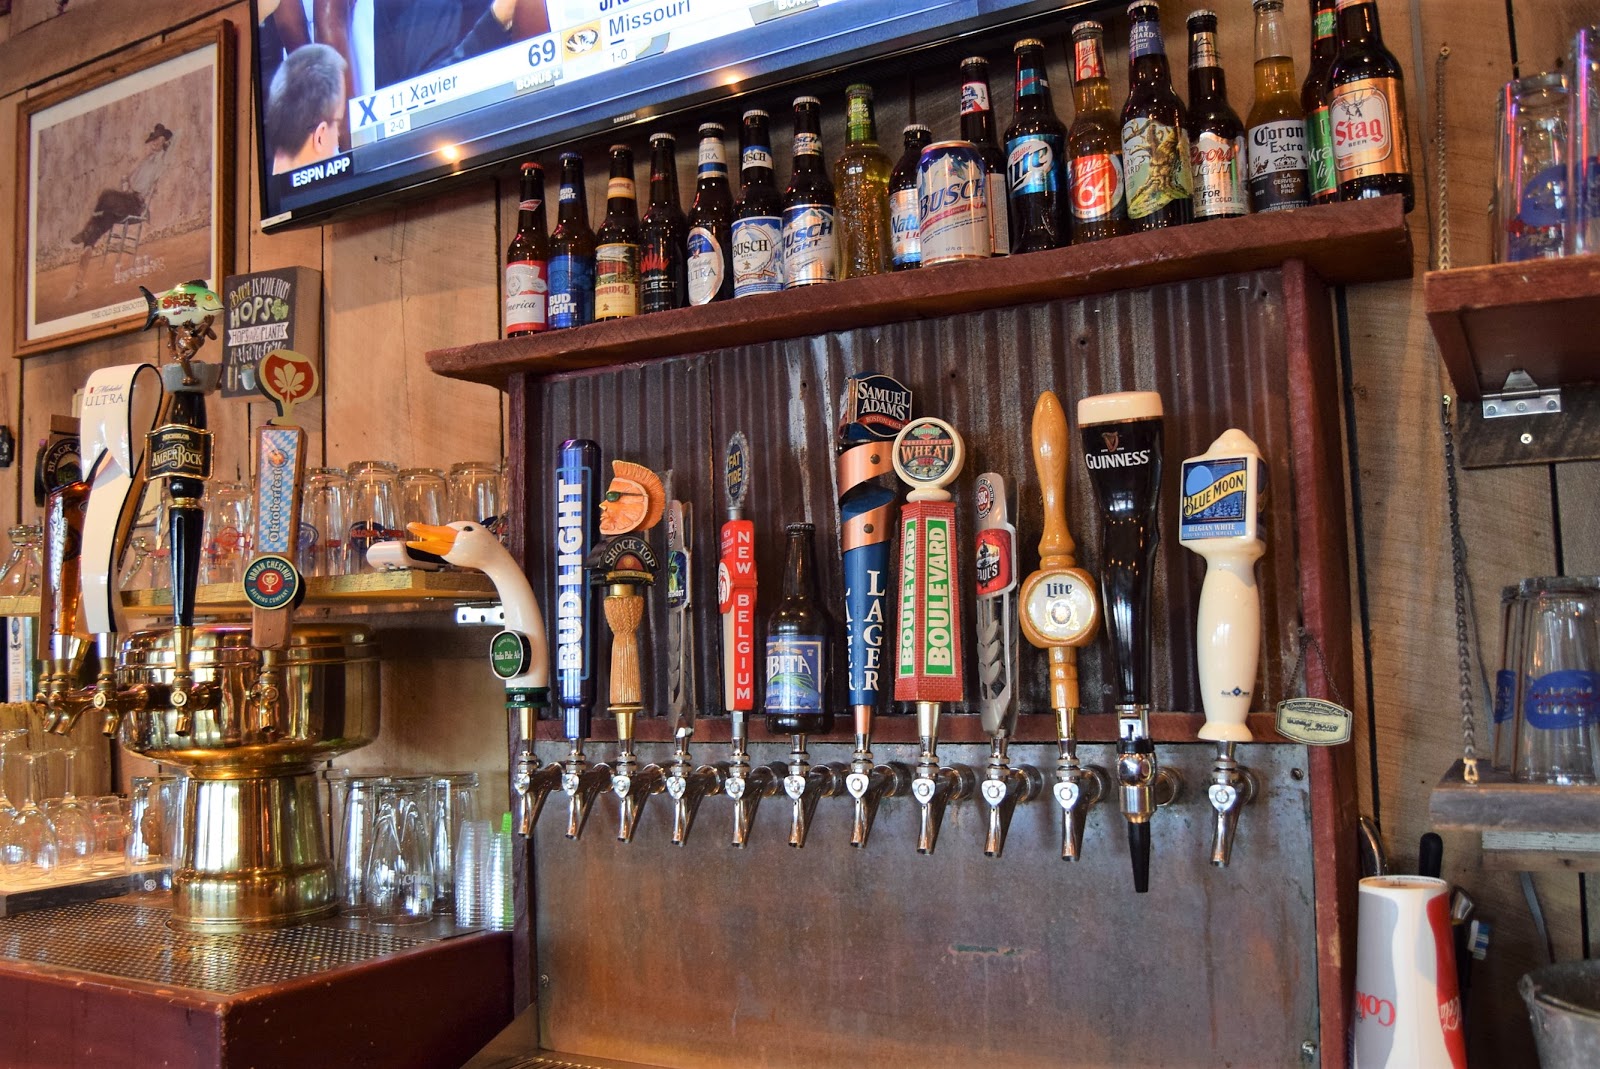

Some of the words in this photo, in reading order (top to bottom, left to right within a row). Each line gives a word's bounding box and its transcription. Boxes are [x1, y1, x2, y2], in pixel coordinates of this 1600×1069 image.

[608, 0, 691, 37] Missouri
[527, 39, 556, 67] 69
[409, 74, 459, 102] Xavier
[358, 95, 379, 126] X
[613, 112, 637, 124] SAMSUNG
[389, 118, 405, 133] 2-0
[1254, 126, 1304, 147] Coron
[1335, 118, 1384, 147] Stag
[1011, 144, 1032, 161] Miller
[1270, 140, 1304, 154] Extra
[1348, 139, 1367, 148] BEER
[1190, 146, 1233, 166] Coors
[292, 164, 325, 188] ESPN
[325, 156, 351, 178] APP
[1008, 146, 1048, 192] Lite
[1073, 158, 1109, 182] Miller
[1355, 167, 1364, 176] 12
[1077, 172, 1111, 208] 64
[1273, 177, 1301, 185] CERVEZA
[920, 178, 984, 221] BUSCH
[1203, 190, 1220, 198] FOR
[733, 239, 769, 258] BUSCH
[785, 239, 821, 259] LIGHT
[549, 292, 571, 306] BUD
[230, 296, 273, 328] HOPS
[232, 329, 249, 342] HOPS
[260, 323, 286, 341] PLANTS
[85, 393, 125, 407] ULTRA
[858, 381, 910, 409] SAMUEL
[861, 398, 906, 421] ADAMS
[865, 416, 888, 425] BOSTON
[888, 420, 904, 430] LAGE
[47, 443, 72, 473] BLACK
[729, 451, 741, 468] FAT
[901, 445, 952, 465] WHEAT
[1085, 449, 1150, 471] GUINNESS
[727, 467, 743, 487] TIRE
[268, 466, 284, 542] Oktoberfest
[1184, 489, 1212, 517] BLUE
[1213, 474, 1244, 499] MOON
[558, 479, 583, 585] LIGHT
[1188, 524, 1214, 532] BELGIAN
[1214, 523, 1236, 531] WHITE
[604, 539, 637, 567] SHOCK
[639, 544, 656, 568] TOP
[736, 531, 751, 575] NEW
[248, 561, 266, 582] URBAN
[266, 559, 293, 582] CHESTNUT
[250, 587, 269, 604] BREWING
[268, 588, 289, 604] COMPANY
[901, 527, 915, 667] BOULEVARD
[928, 526, 951, 667] BOULEVARD
[1046, 583, 1073, 598] Lite
[558, 590, 583, 669] BUD
[863, 569, 886, 691] LAGER
[737, 595, 750, 700] BELGIUM
